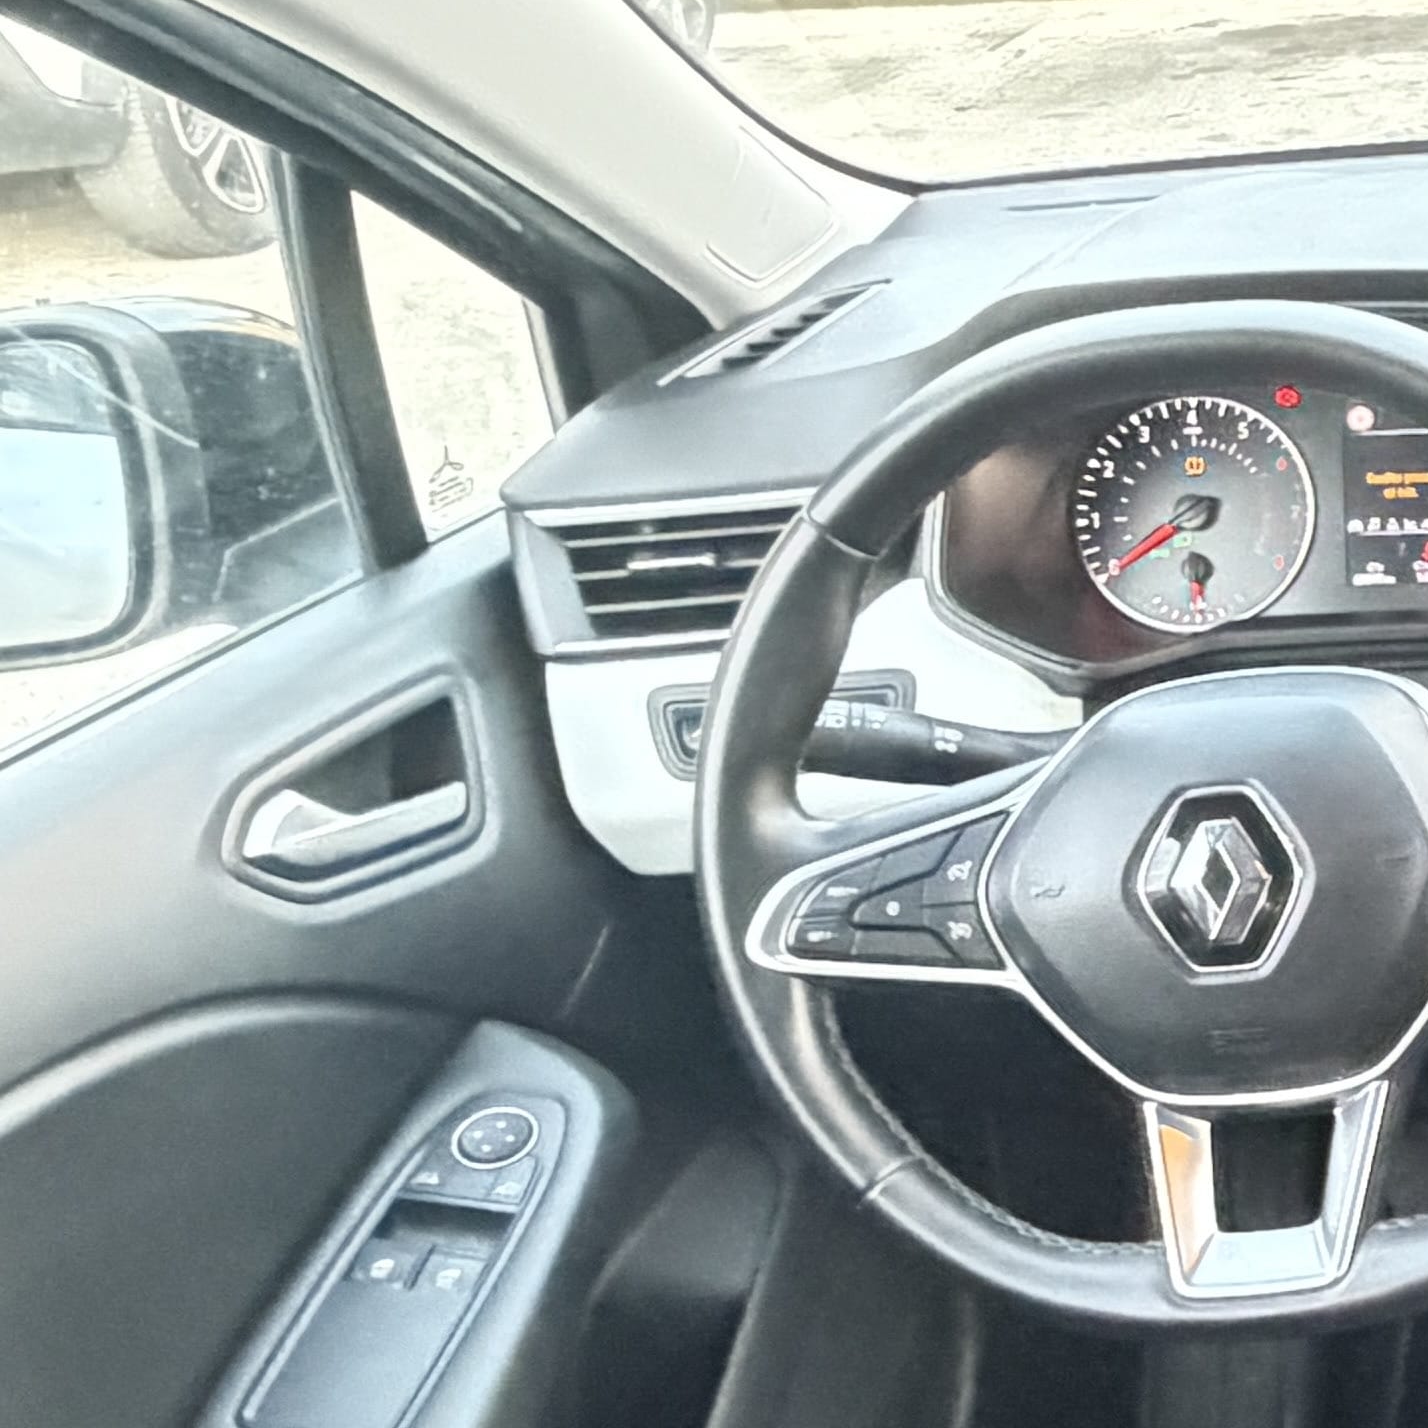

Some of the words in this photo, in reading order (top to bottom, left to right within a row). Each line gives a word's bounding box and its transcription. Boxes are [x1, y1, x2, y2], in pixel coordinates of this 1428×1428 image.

[1138, 425, 1151, 444] 3
[1237, 421, 1250, 440] 5
[1102, 460, 1115, 479] 2
